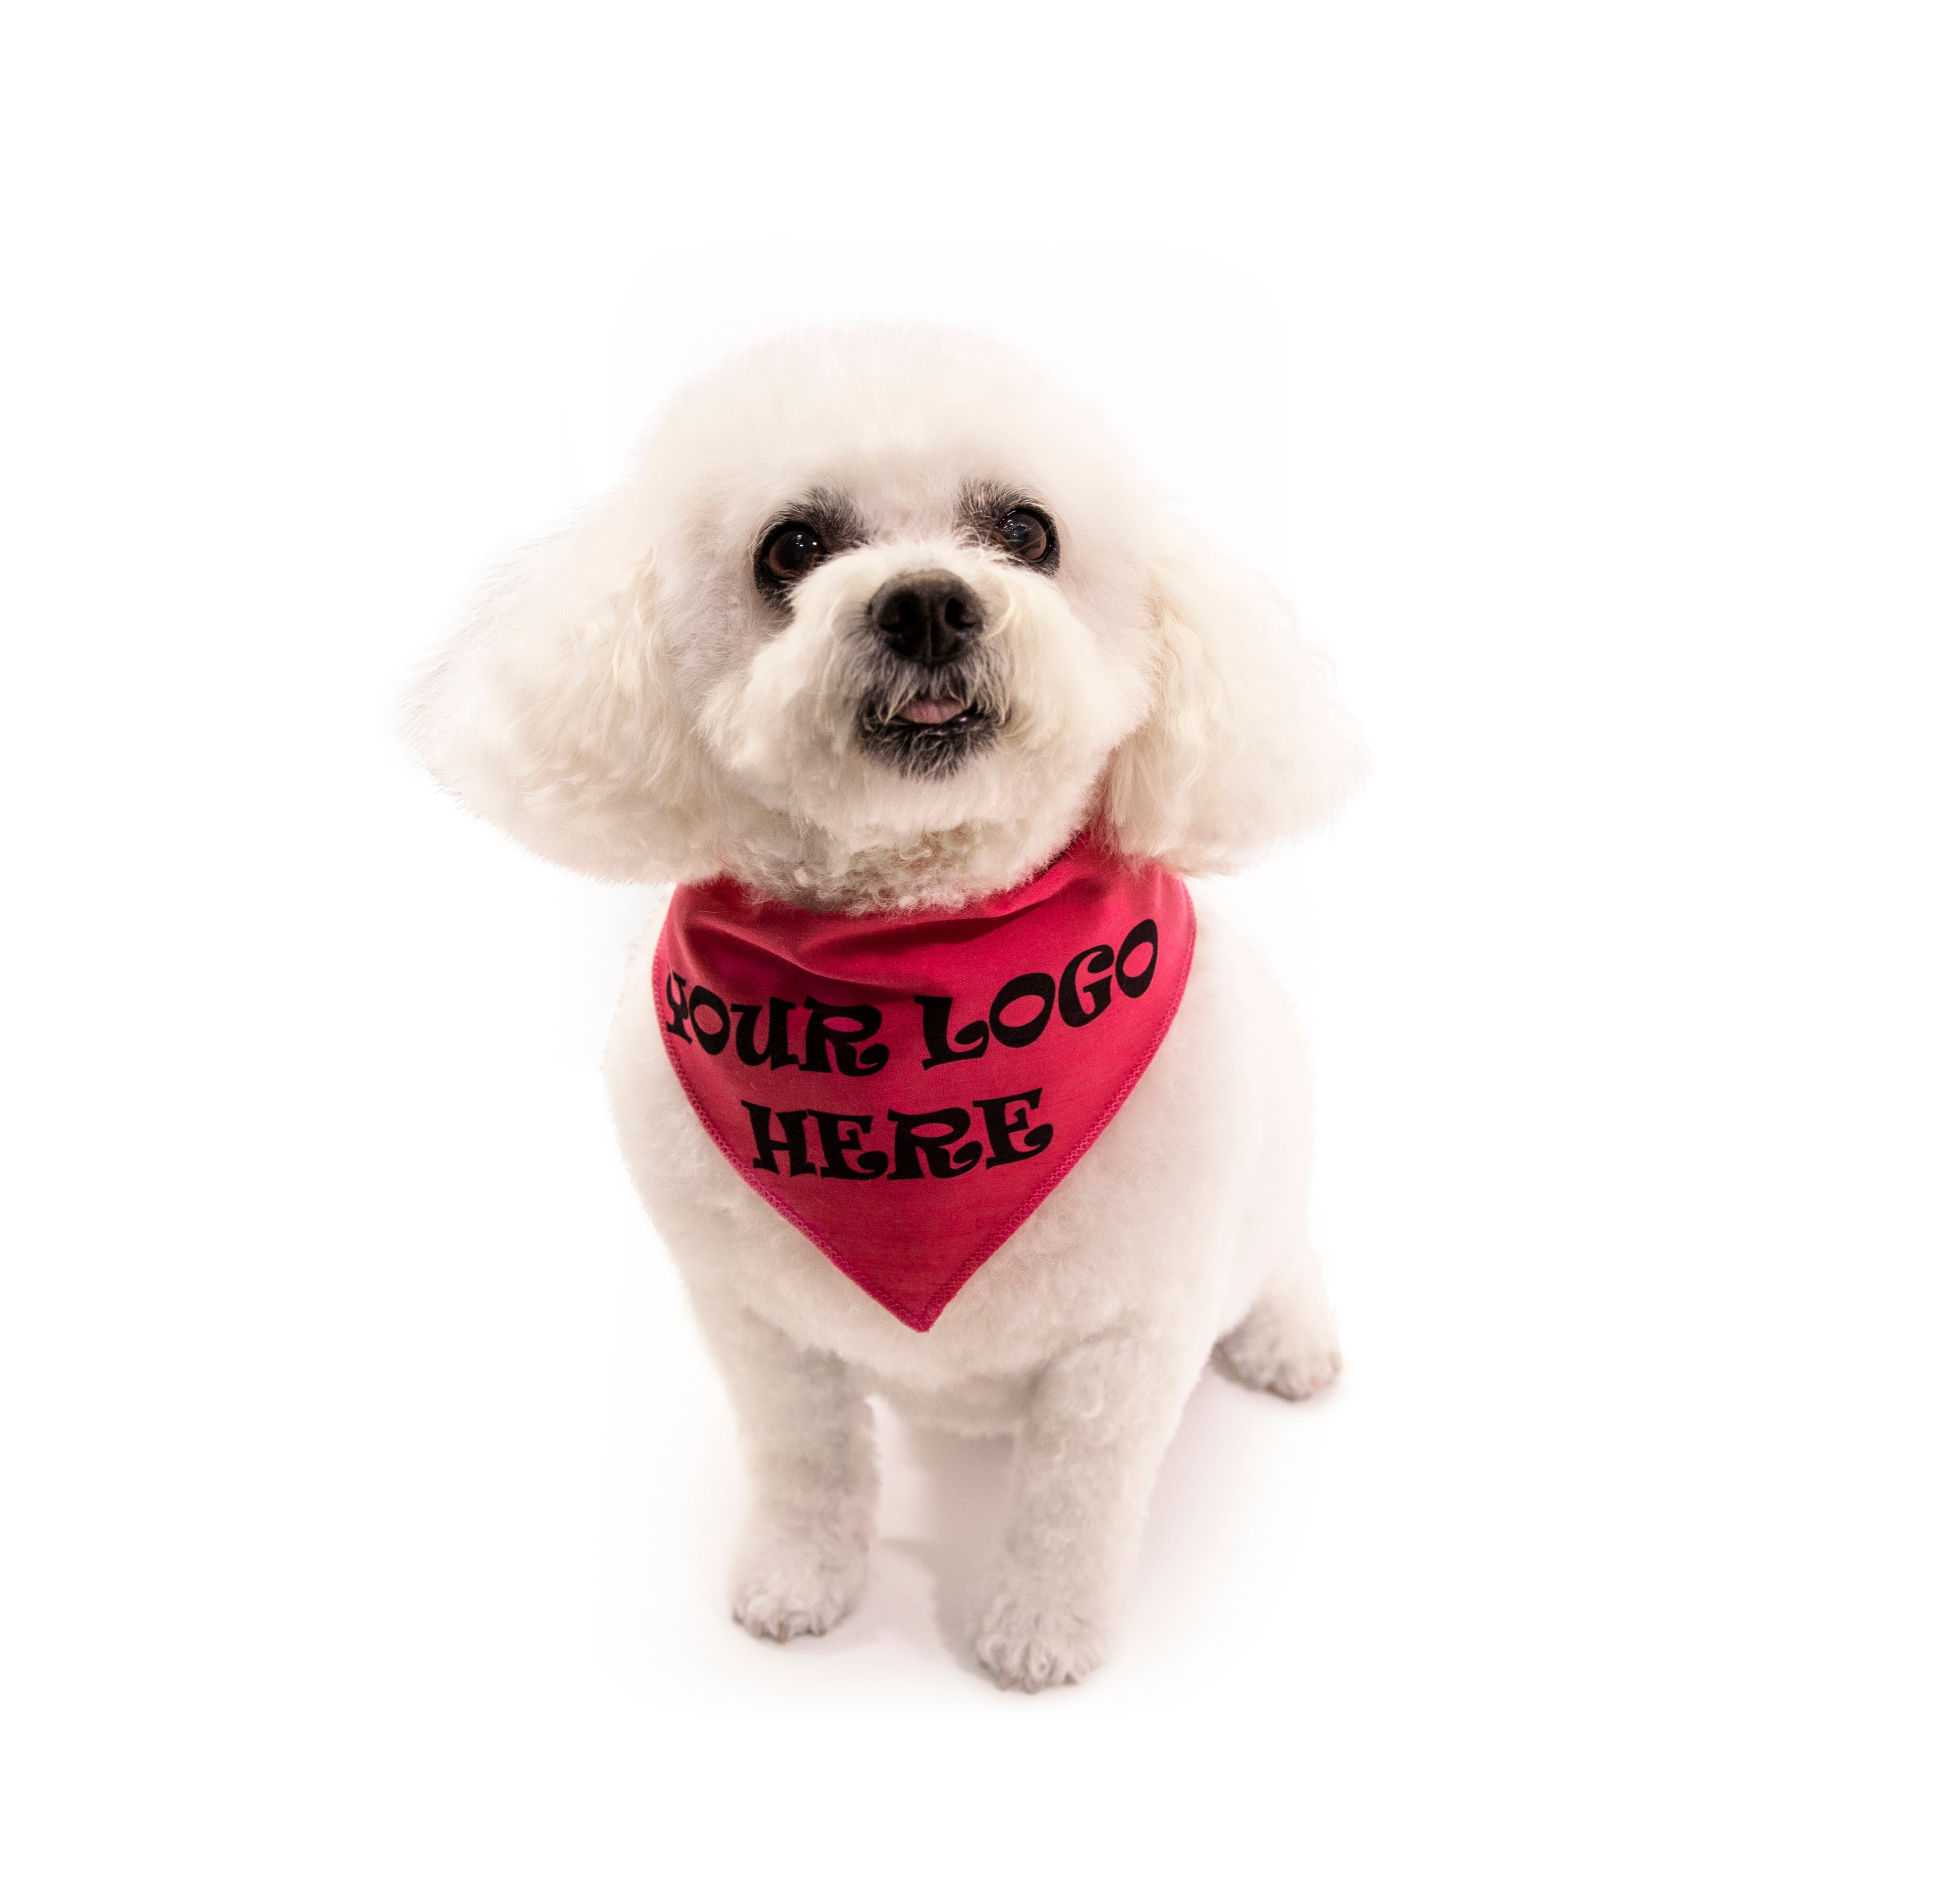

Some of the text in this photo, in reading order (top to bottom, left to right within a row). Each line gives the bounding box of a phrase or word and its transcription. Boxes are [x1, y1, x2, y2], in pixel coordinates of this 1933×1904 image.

[664, 918, 1159, 1077] YOUR LOGO
[740, 1087, 1053, 1180] HERE
